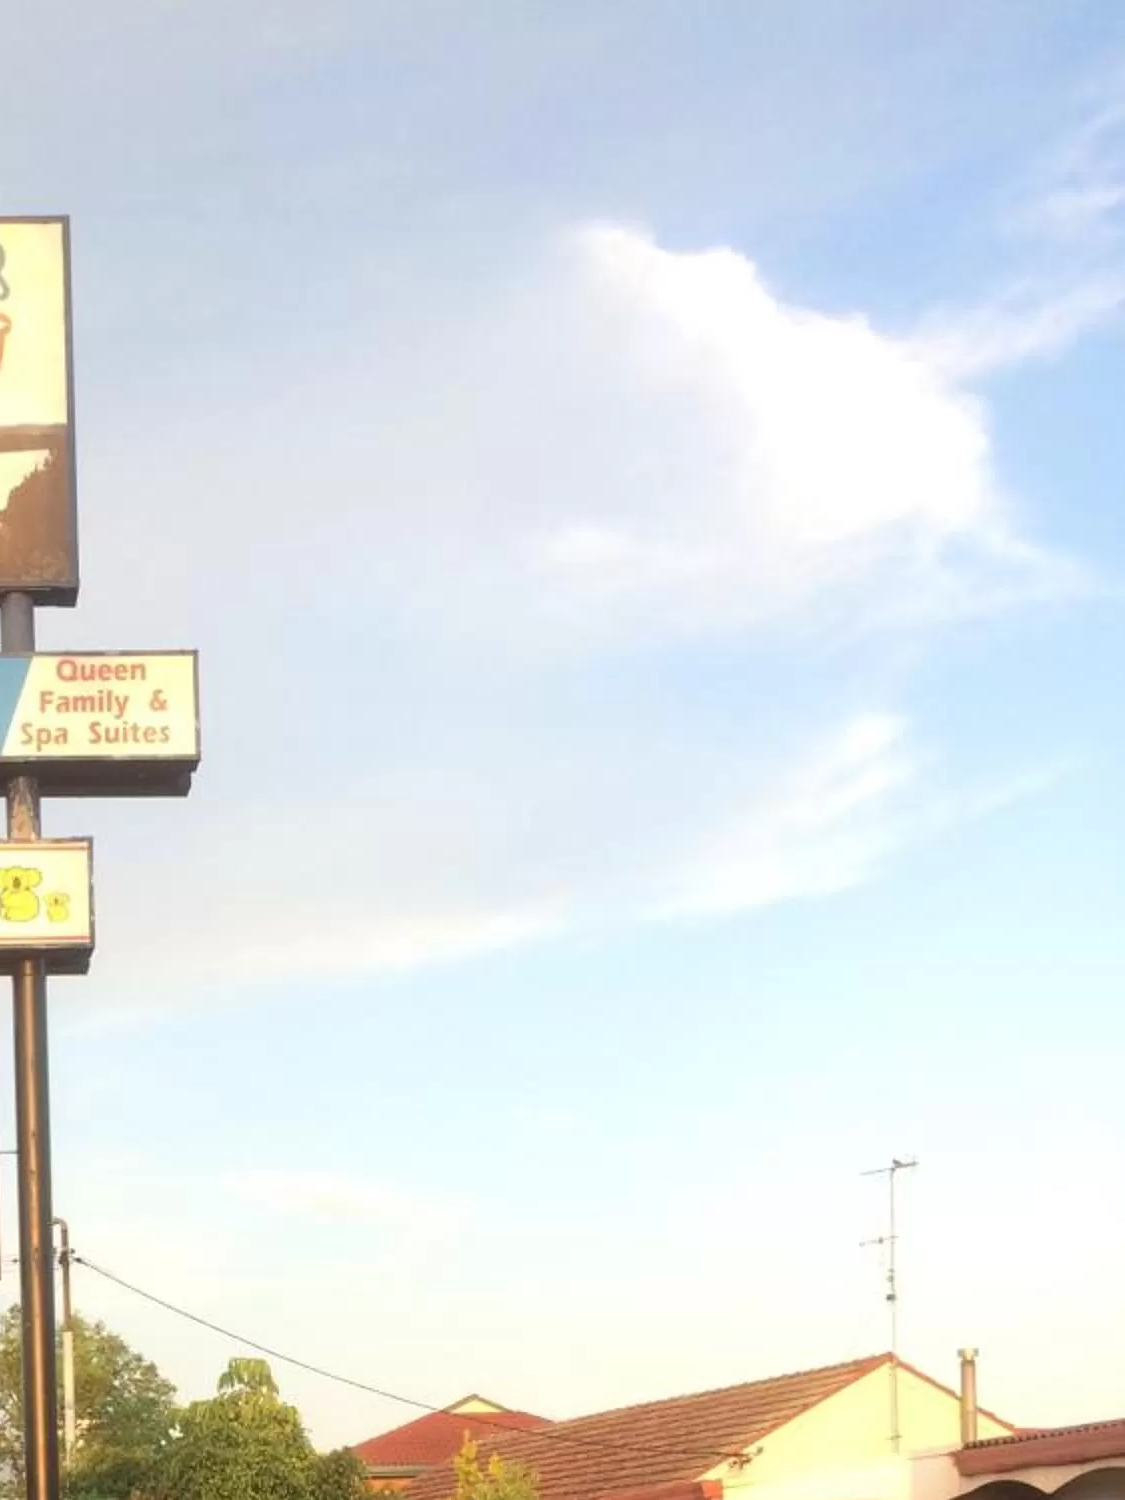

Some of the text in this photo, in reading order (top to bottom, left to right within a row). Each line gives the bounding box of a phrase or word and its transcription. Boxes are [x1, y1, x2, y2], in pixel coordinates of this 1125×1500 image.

[56, 659, 147, 683] Queen
[39, 688, 168, 719] Family &
[20, 721, 170, 752] Spa Suites
